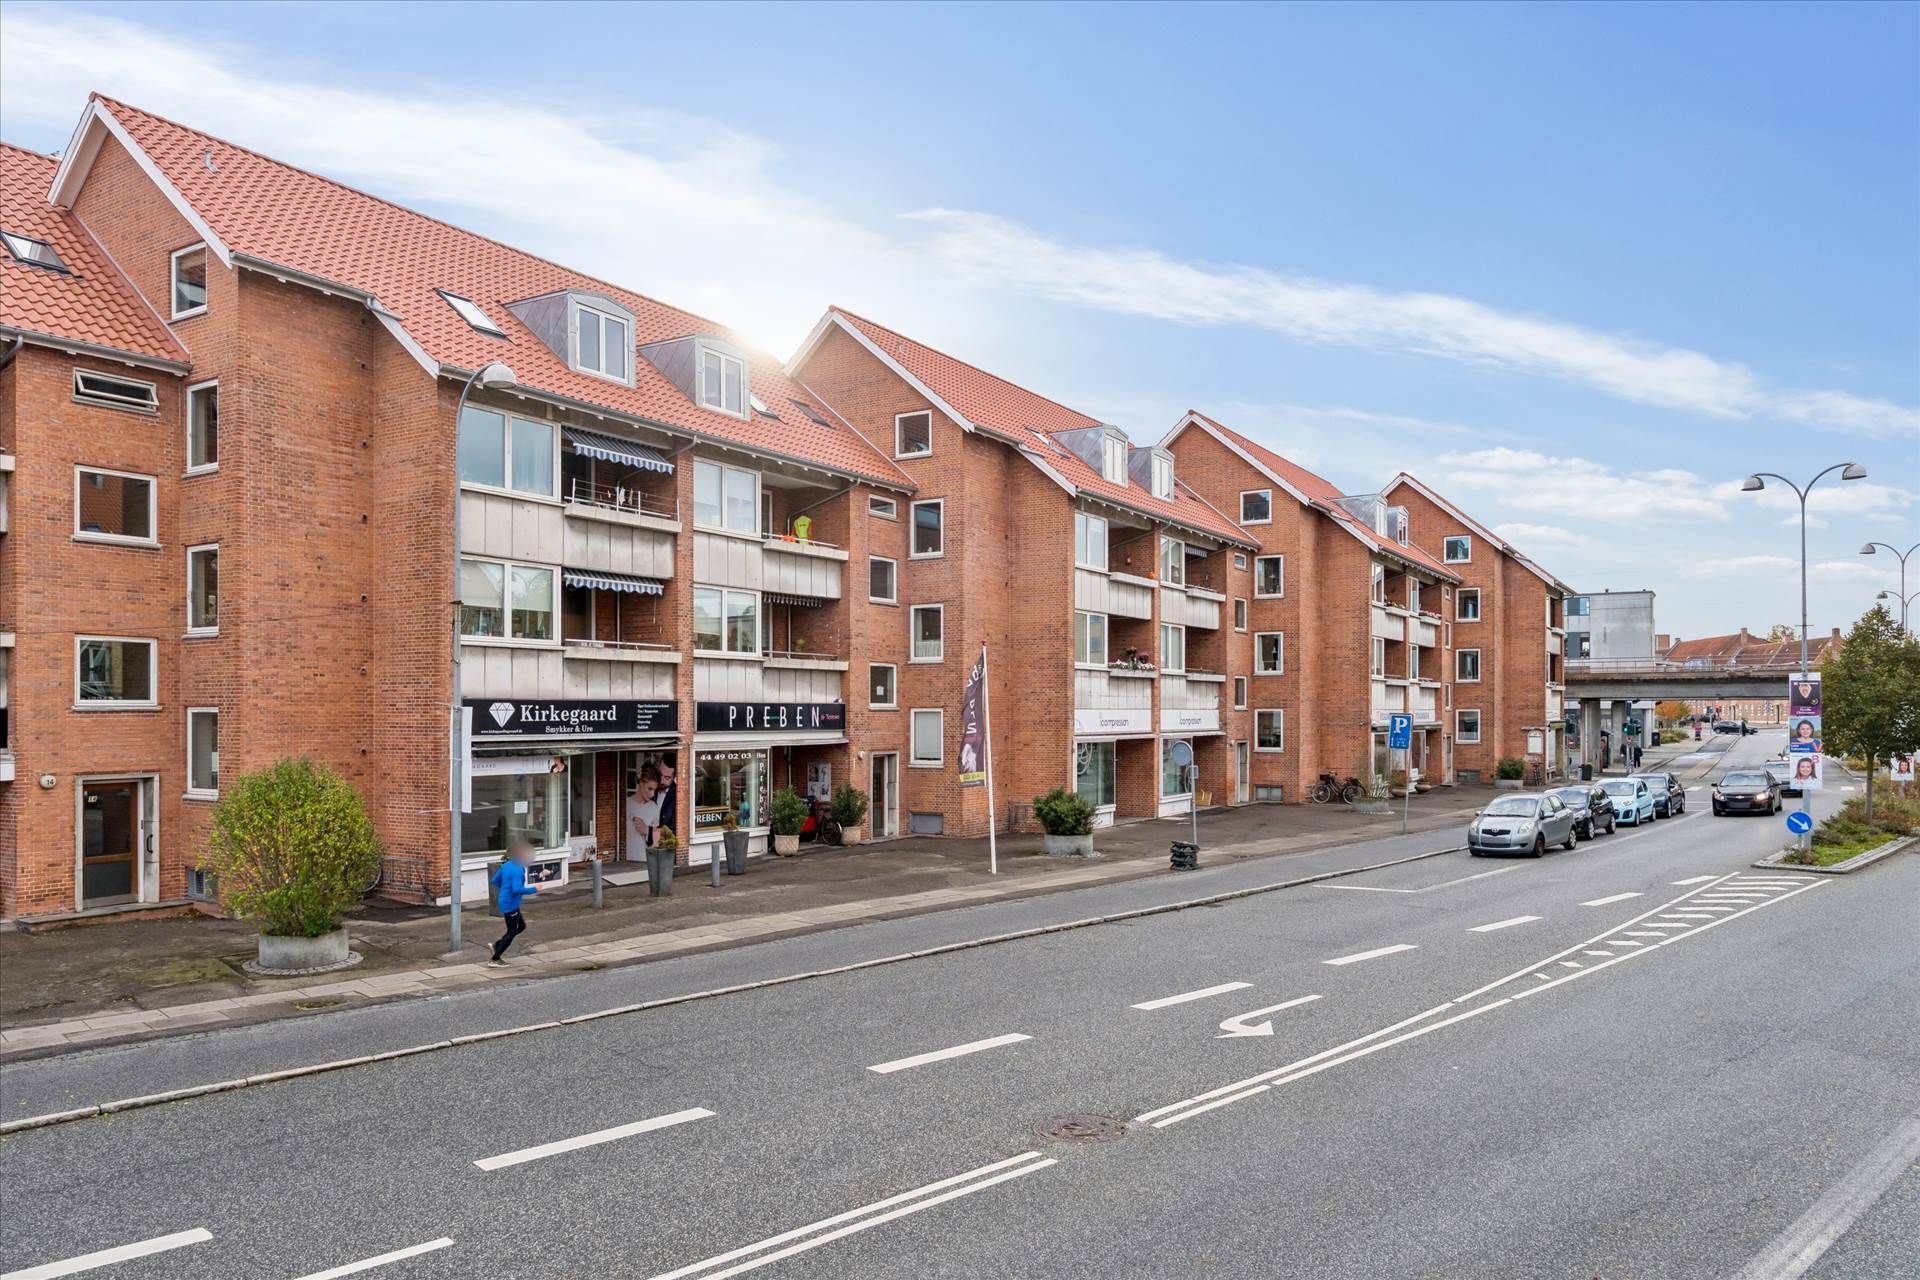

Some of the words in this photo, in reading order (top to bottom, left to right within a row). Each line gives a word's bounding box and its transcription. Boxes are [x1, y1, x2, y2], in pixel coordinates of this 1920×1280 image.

[520, 704, 617, 725] Kirkegaard
[729, 706, 820, 728] PREBEN
[545, 725, 573, 735] Smykker
[574, 725, 580, 733] &
[581, 725, 593, 733] Ure
[1394, 717, 1408, 734] P
